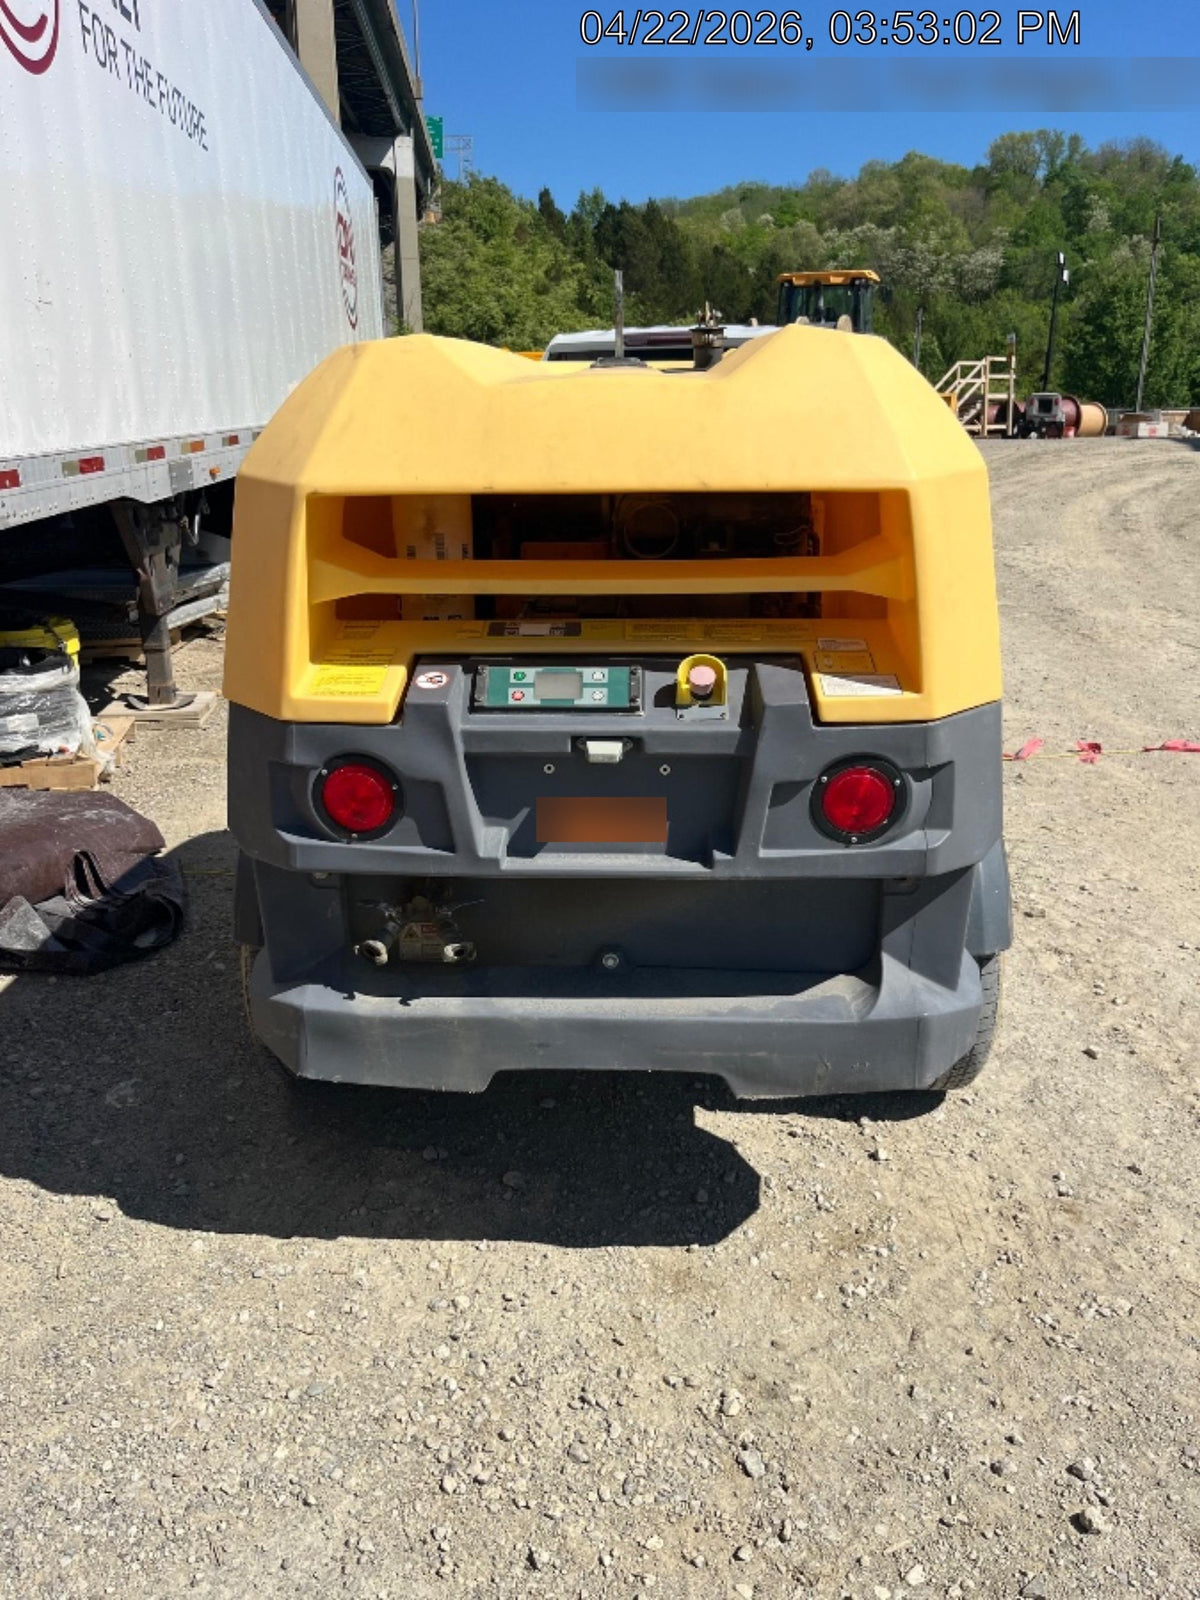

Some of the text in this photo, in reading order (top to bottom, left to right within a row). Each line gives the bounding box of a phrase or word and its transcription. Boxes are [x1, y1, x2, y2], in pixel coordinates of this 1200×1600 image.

[77, 0, 121, 81] FOR
[120, 38, 157, 109] THE
[156, 70, 209, 152] FUTURE
